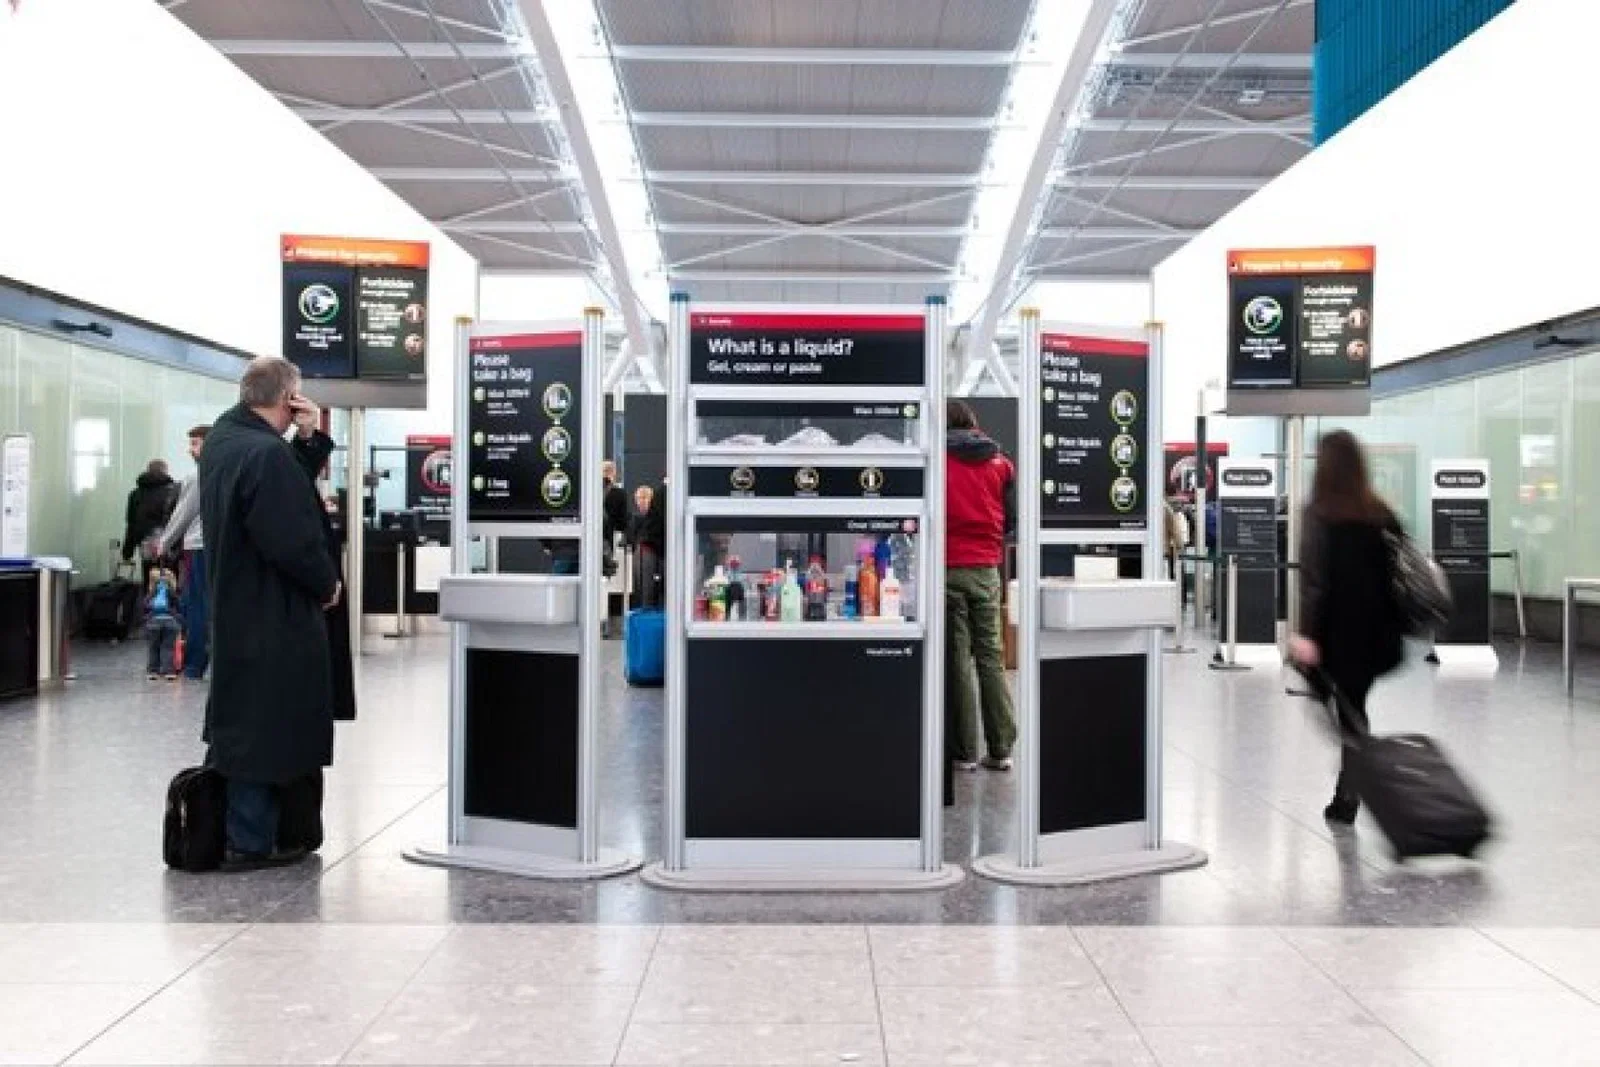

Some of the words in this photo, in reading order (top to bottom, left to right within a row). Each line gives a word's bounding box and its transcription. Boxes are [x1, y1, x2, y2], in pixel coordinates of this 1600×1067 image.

[708, 338, 756, 356] What
[760, 338, 775, 356] is
[778, 341, 791, 355] a
[794, 337, 854, 359] liquid?
[474, 353, 510, 367] Please
[1042, 352, 1079, 367] Please
[474, 368, 498, 381] take
[500, 369, 508, 381] a
[509, 367, 533, 383] bag
[706, 360, 732, 374] Gel,
[733, 362, 771, 373] cream
[773, 362, 788, 373] or
[789, 362, 823, 375] paste
[1042, 369, 1068, 382] take
[1069, 372, 1077, 382] a
[1079, 369, 1102, 388] bag
